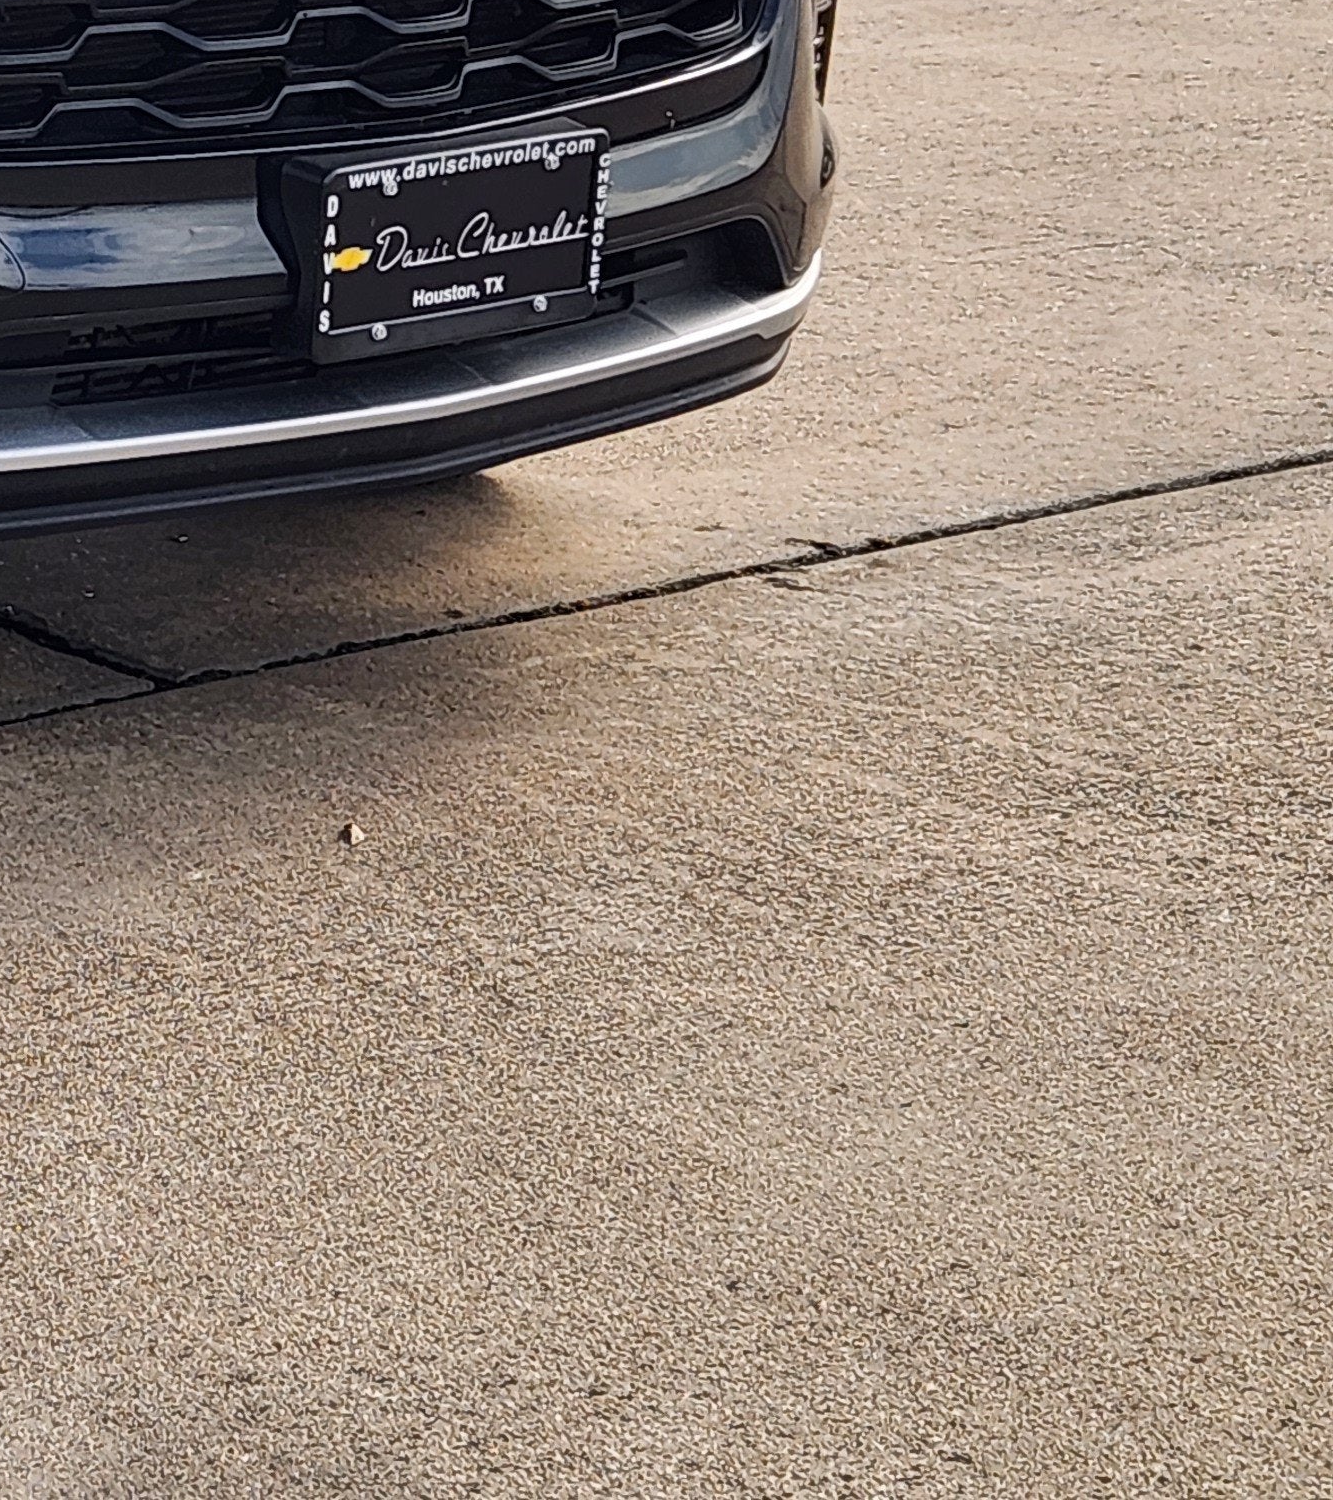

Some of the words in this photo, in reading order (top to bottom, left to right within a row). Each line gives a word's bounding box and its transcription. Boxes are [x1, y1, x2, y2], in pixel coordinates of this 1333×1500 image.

[348, 138, 595, 189] www.davischevrolet.com
[376, 226, 456, 272] Davis
[456, 210, 590, 259] Chevrolet
[588, 153, 611, 295] CHEVROLET
[318, 194, 339, 334] DAVIS
[412, 283, 480, 308] Houston,
[483, 275, 505, 296] TX
